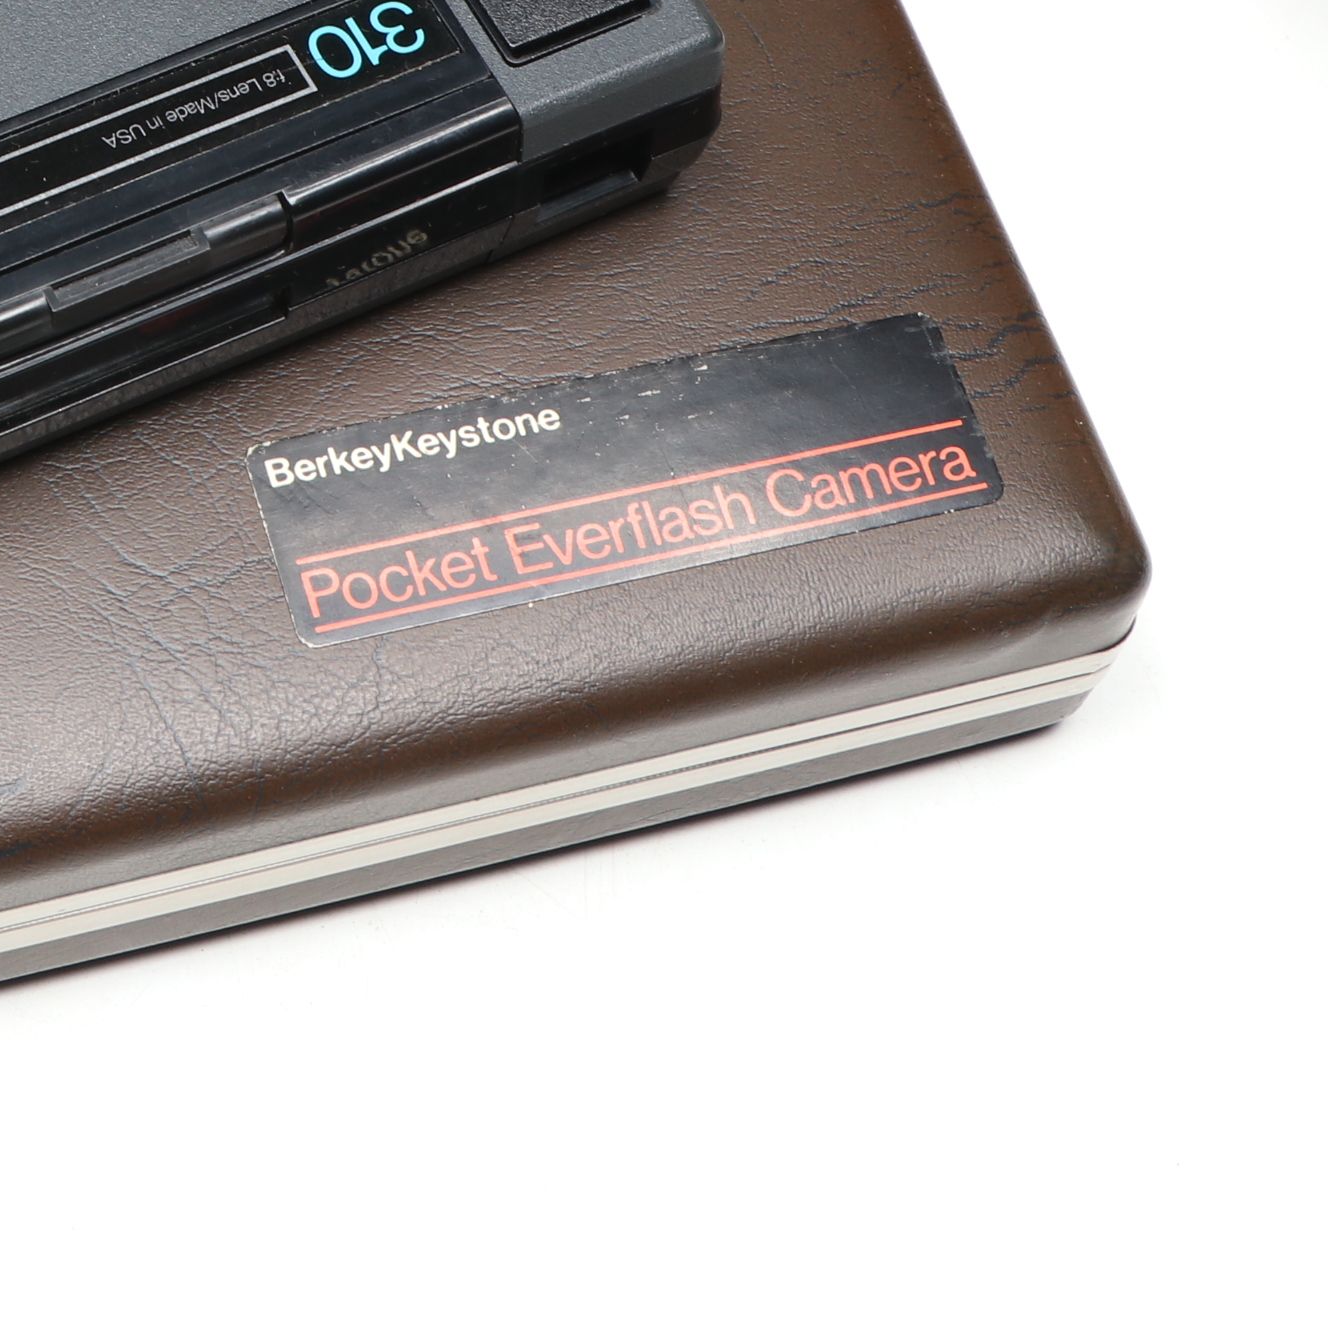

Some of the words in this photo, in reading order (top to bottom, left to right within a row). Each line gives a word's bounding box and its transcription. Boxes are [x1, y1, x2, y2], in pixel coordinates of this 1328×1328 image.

[308, 0, 425, 79] 310
[148, 114, 167, 131] in
[166, 75, 263, 123] Lens/Made
[101, 123, 147, 149] USA
[264, 408, 562, 489] BerkeyKeystone
[300, 536, 498, 618] Pocket
[503, 483, 757, 575] Everflash
[765, 445, 977, 518] Camera
